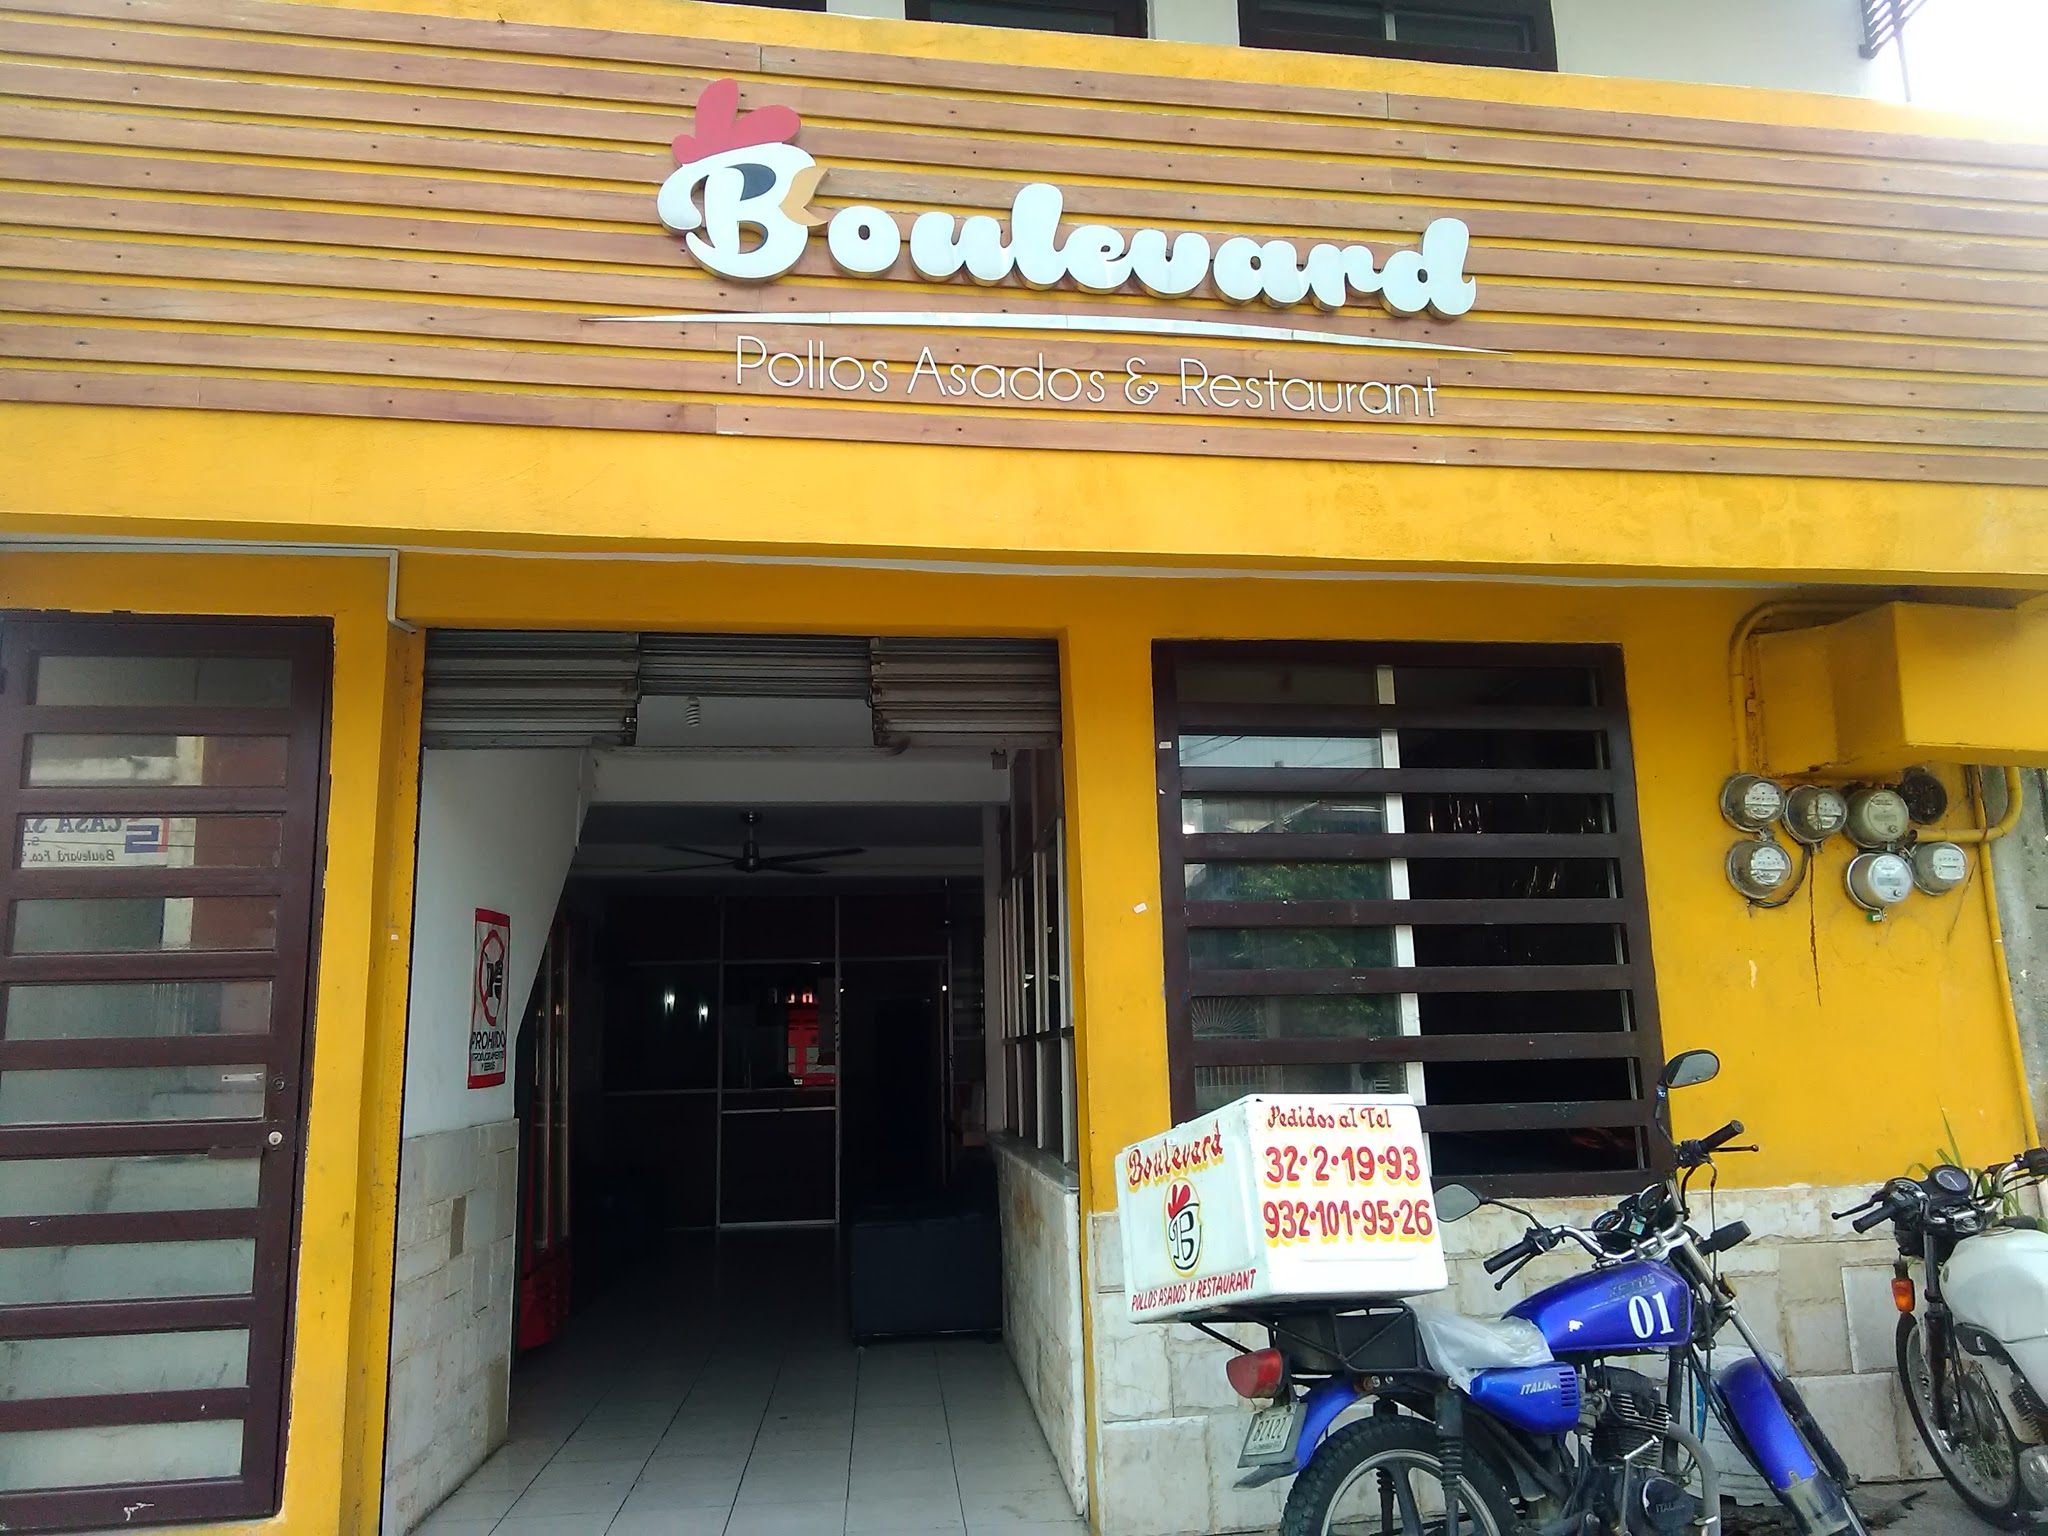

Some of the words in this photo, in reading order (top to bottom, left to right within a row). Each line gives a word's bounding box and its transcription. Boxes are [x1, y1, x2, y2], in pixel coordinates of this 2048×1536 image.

[656, 141, 1477, 320] Boulevard
[735, 335, 889, 393] Pollos
[906, 346, 1106, 403] Asados
[1124, 356, 1160, 406] &
[1180, 357, 1438, 417] Restaurant
[1267, 1105, 1335, 1129] Pedidos
[1339, 1107, 1358, 1128] al
[1360, 1107, 1392, 1129] Tel
[1127, 1119, 1224, 1188] Boulevard
[1131, 1292, 1157, 1312] POLLOS
[1157, 1284, 1187, 1306] ASADOS
[1188, 1282, 1196, 1302] Y
[1196, 1269, 1257, 1300] RESTAURANT
[1628, 1291, 1675, 1339] 01
